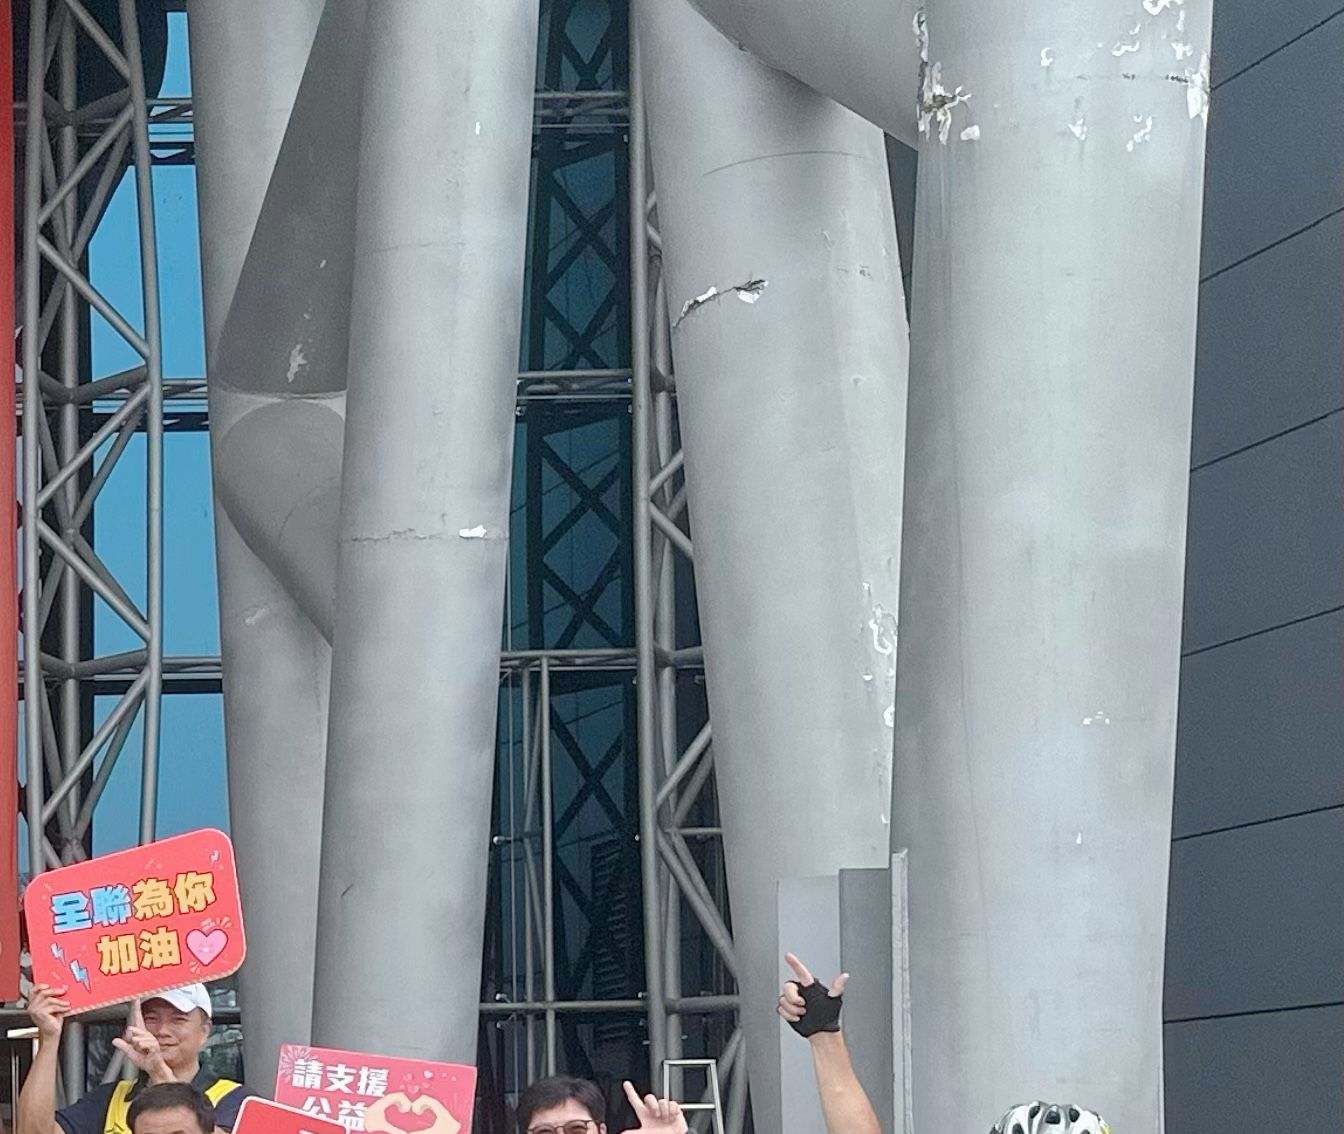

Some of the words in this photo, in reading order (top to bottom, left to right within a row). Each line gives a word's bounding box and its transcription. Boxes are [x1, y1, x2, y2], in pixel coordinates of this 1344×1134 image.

[51, 871, 218, 934] 全聯為你
[96, 927, 181, 977] 加油
[291, 1058, 390, 1098] 請支援
[301, 1095, 369, 1132] 公益
